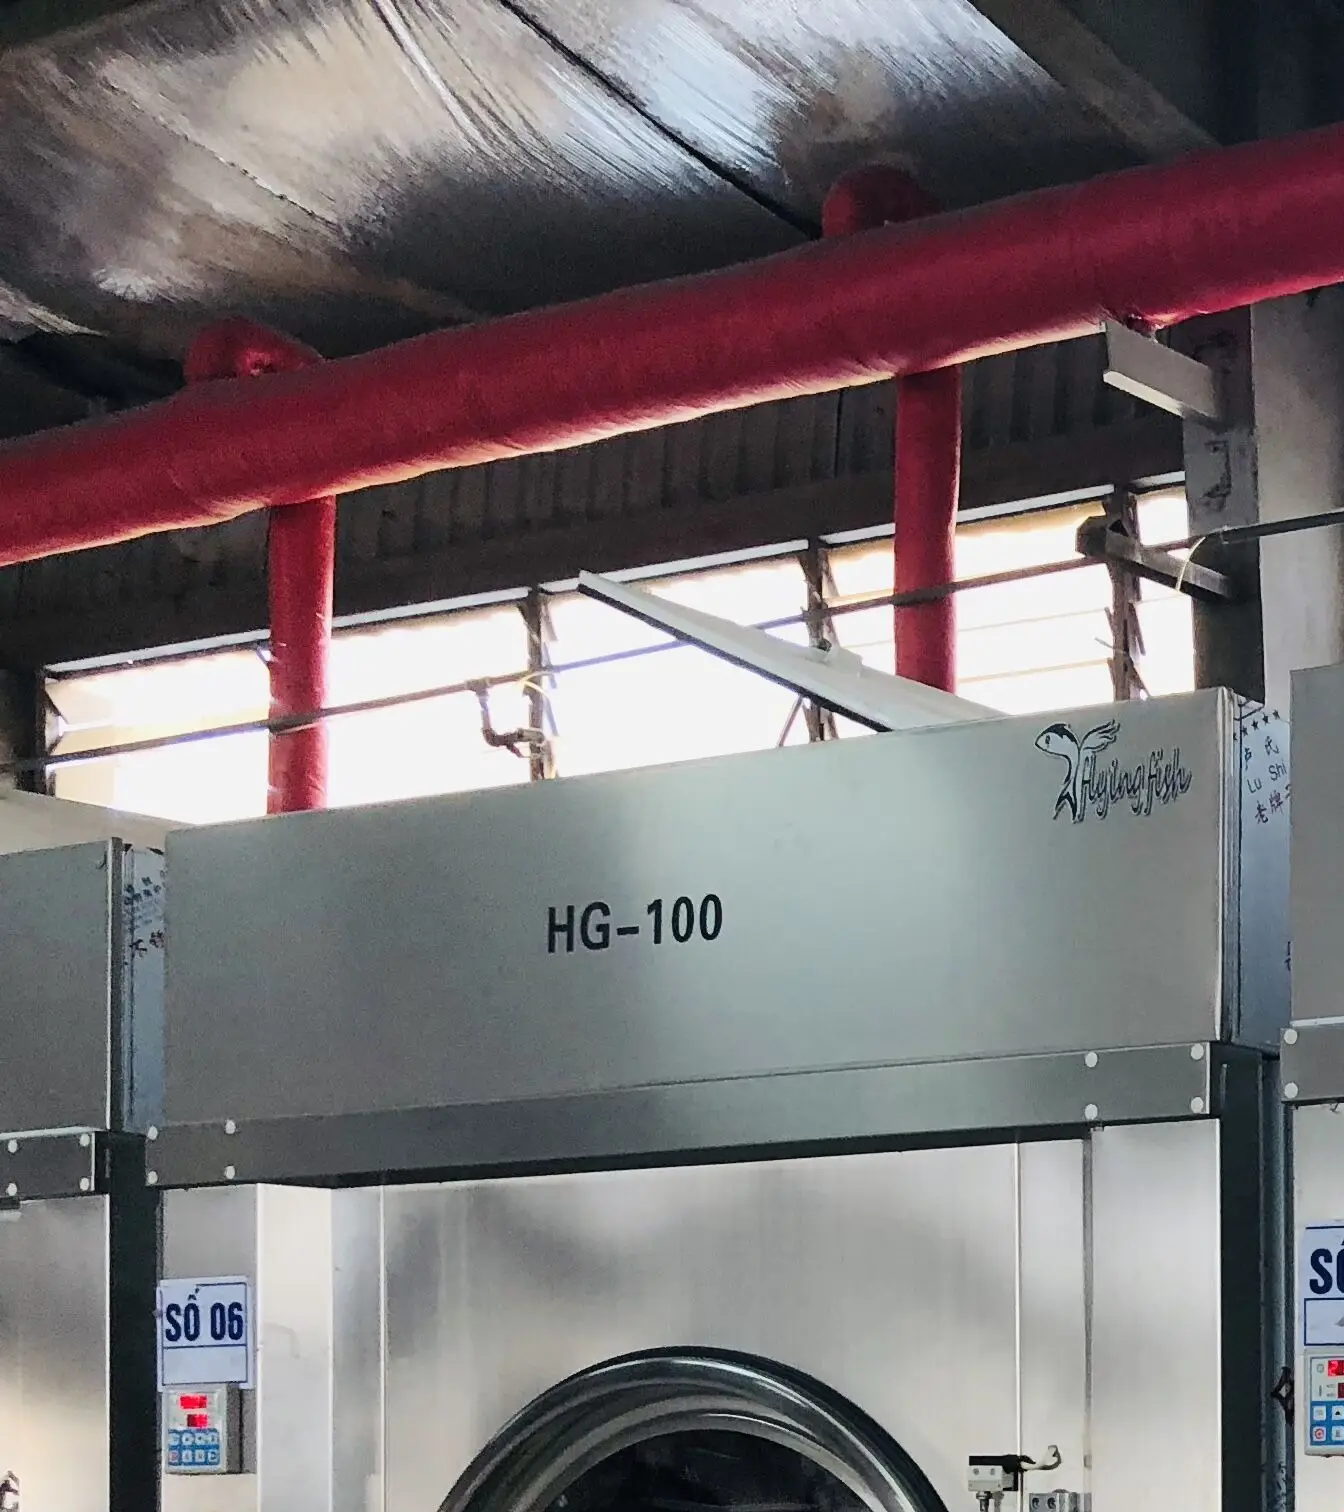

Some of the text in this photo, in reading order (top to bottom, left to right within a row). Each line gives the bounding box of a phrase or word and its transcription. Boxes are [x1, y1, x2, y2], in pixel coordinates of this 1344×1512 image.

[547, 893, 723, 953] HG-100
[165, 1287, 244, 1342] SỐ 06
